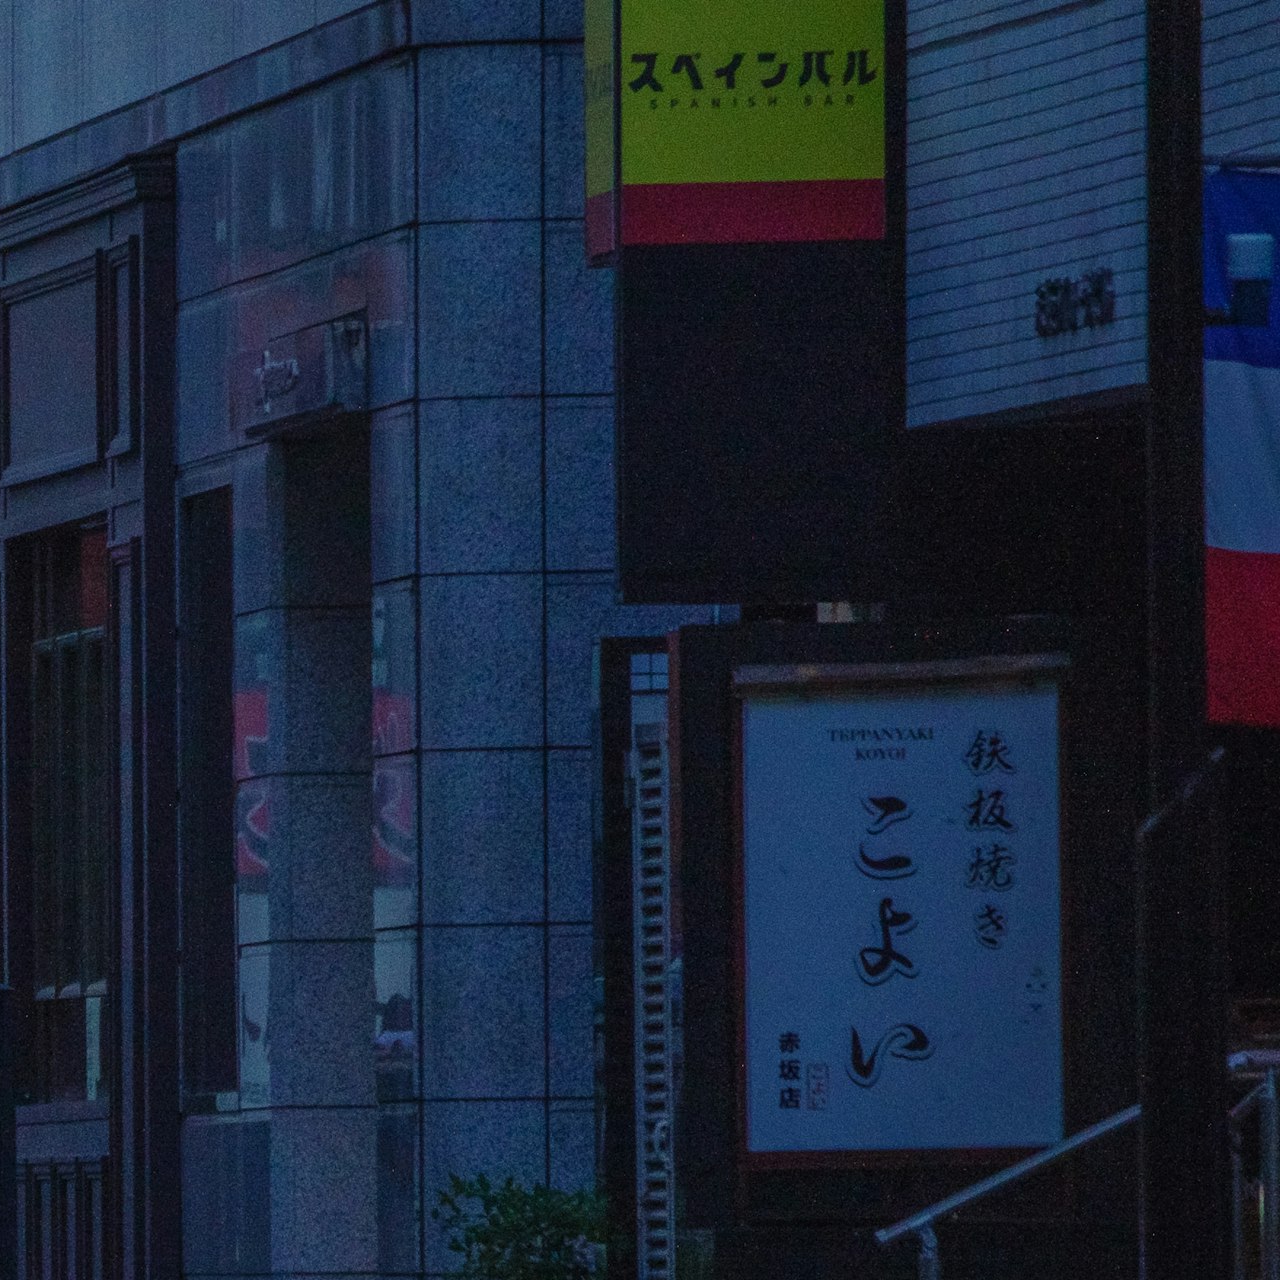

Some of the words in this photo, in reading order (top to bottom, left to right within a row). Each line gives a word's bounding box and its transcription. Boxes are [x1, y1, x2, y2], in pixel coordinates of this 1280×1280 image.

[628, 49, 877, 92] スペインバル
[648, 95, 780, 110] SPANISH
[804, 94, 855, 106] BAR
[826, 727, 936, 742] TEPPANYAKI
[854, 747, 908, 761] KOYOI
[964, 730, 1017, 950] 鉄板焼き
[845, 793, 935, 1089] こよい
[778, 1031, 802, 1110] 赤坂店
